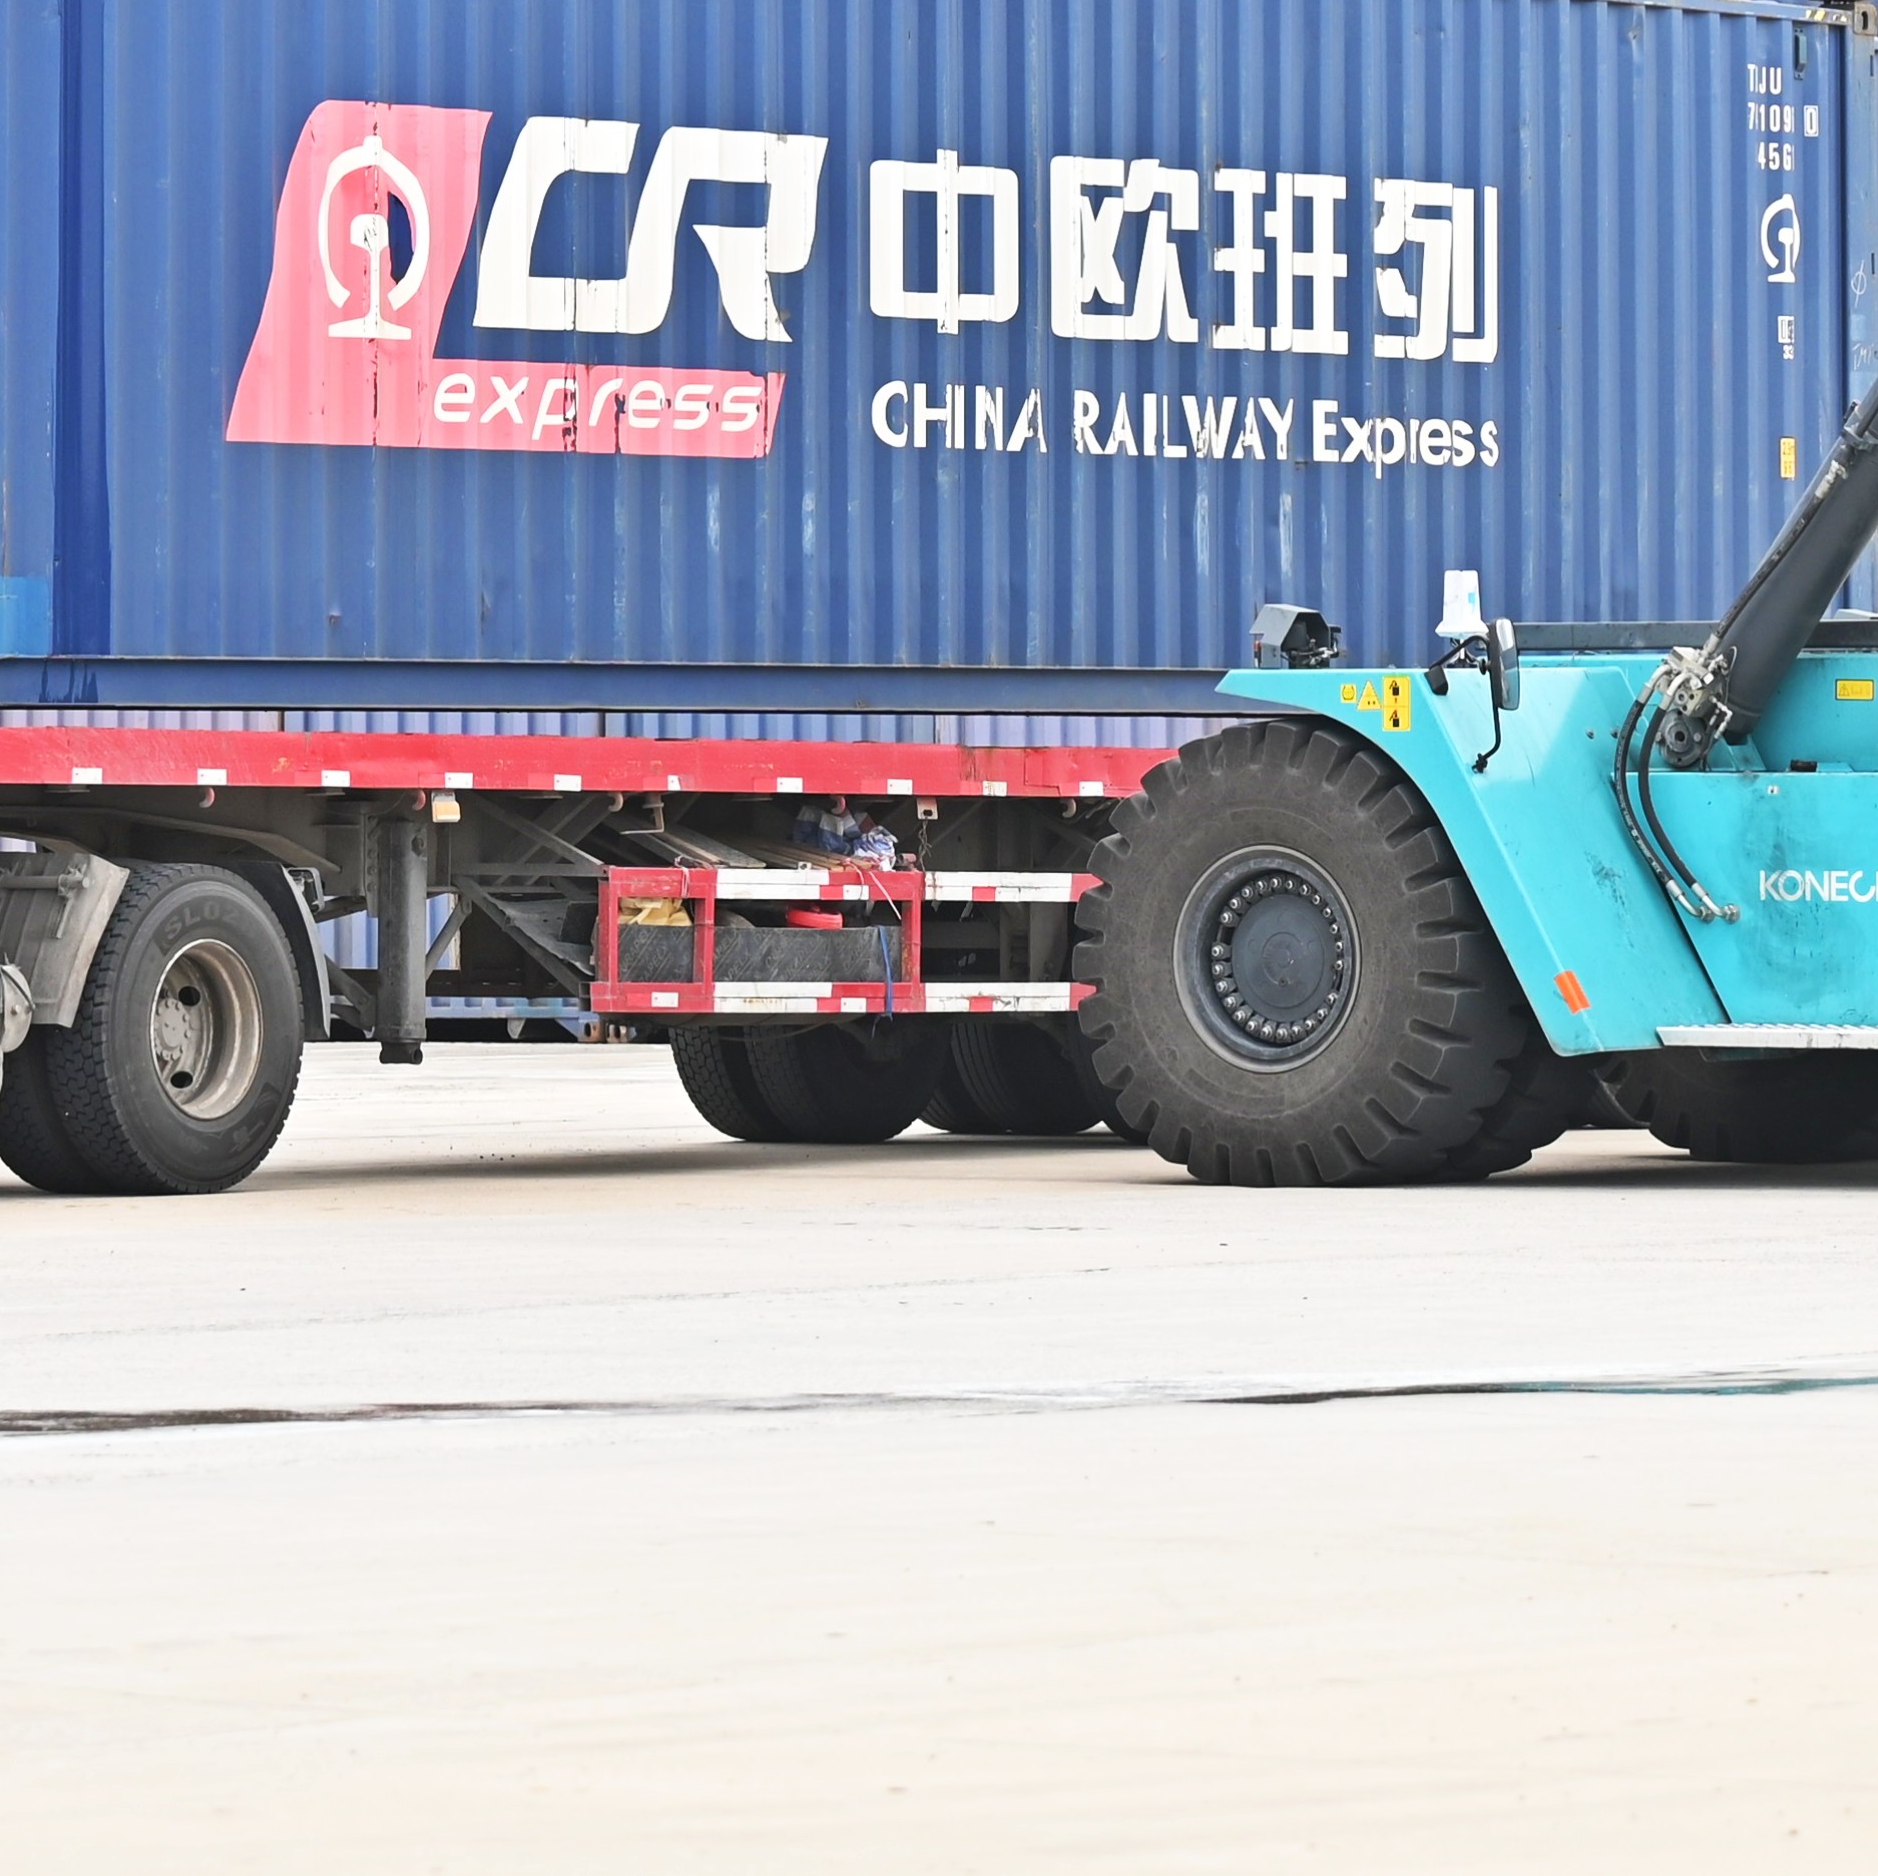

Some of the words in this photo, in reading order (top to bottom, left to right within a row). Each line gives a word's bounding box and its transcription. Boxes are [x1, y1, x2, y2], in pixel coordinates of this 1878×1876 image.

[473, 115, 829, 342] CR
[868, 148, 1500, 363] 中欧班列
[432, 370, 762, 442] express
[871, 379, 1047, 454] CHINA
[1072, 389, 1294, 461] RAILWAY
[1312, 400, 1500, 479] Express
